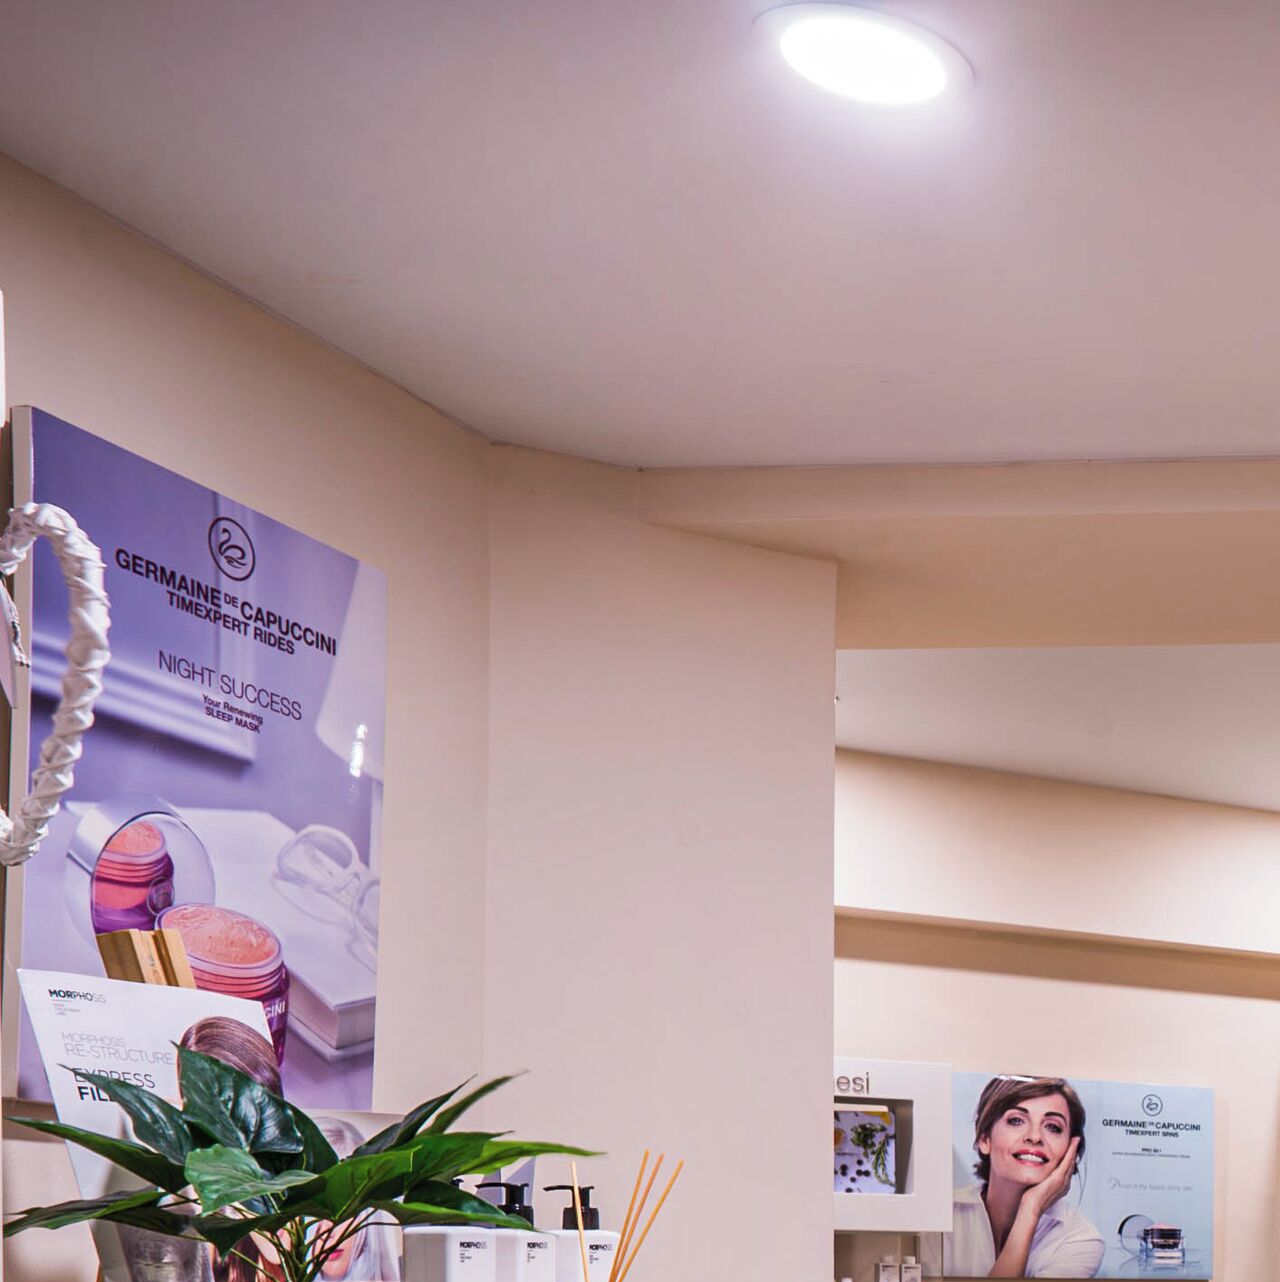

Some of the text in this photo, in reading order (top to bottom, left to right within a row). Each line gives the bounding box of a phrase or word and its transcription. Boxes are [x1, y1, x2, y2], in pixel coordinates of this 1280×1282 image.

[115, 547, 337, 657] GERMAINE DE CAPUCCINI
[167, 589, 295, 655] TIMEXPERT RIDES
[158, 649, 303, 721] NIGHT SUCCESS
[202, 694, 264, 726] Your Renewing
[204, 707, 261, 733] SLEEP MASK
[64, 1042, 176, 1065] RE-STRUCTURE
[1102, 1119, 1147, 1129] GERMAINE
[1155, 1121, 1201, 1131] CAPUCCINI
